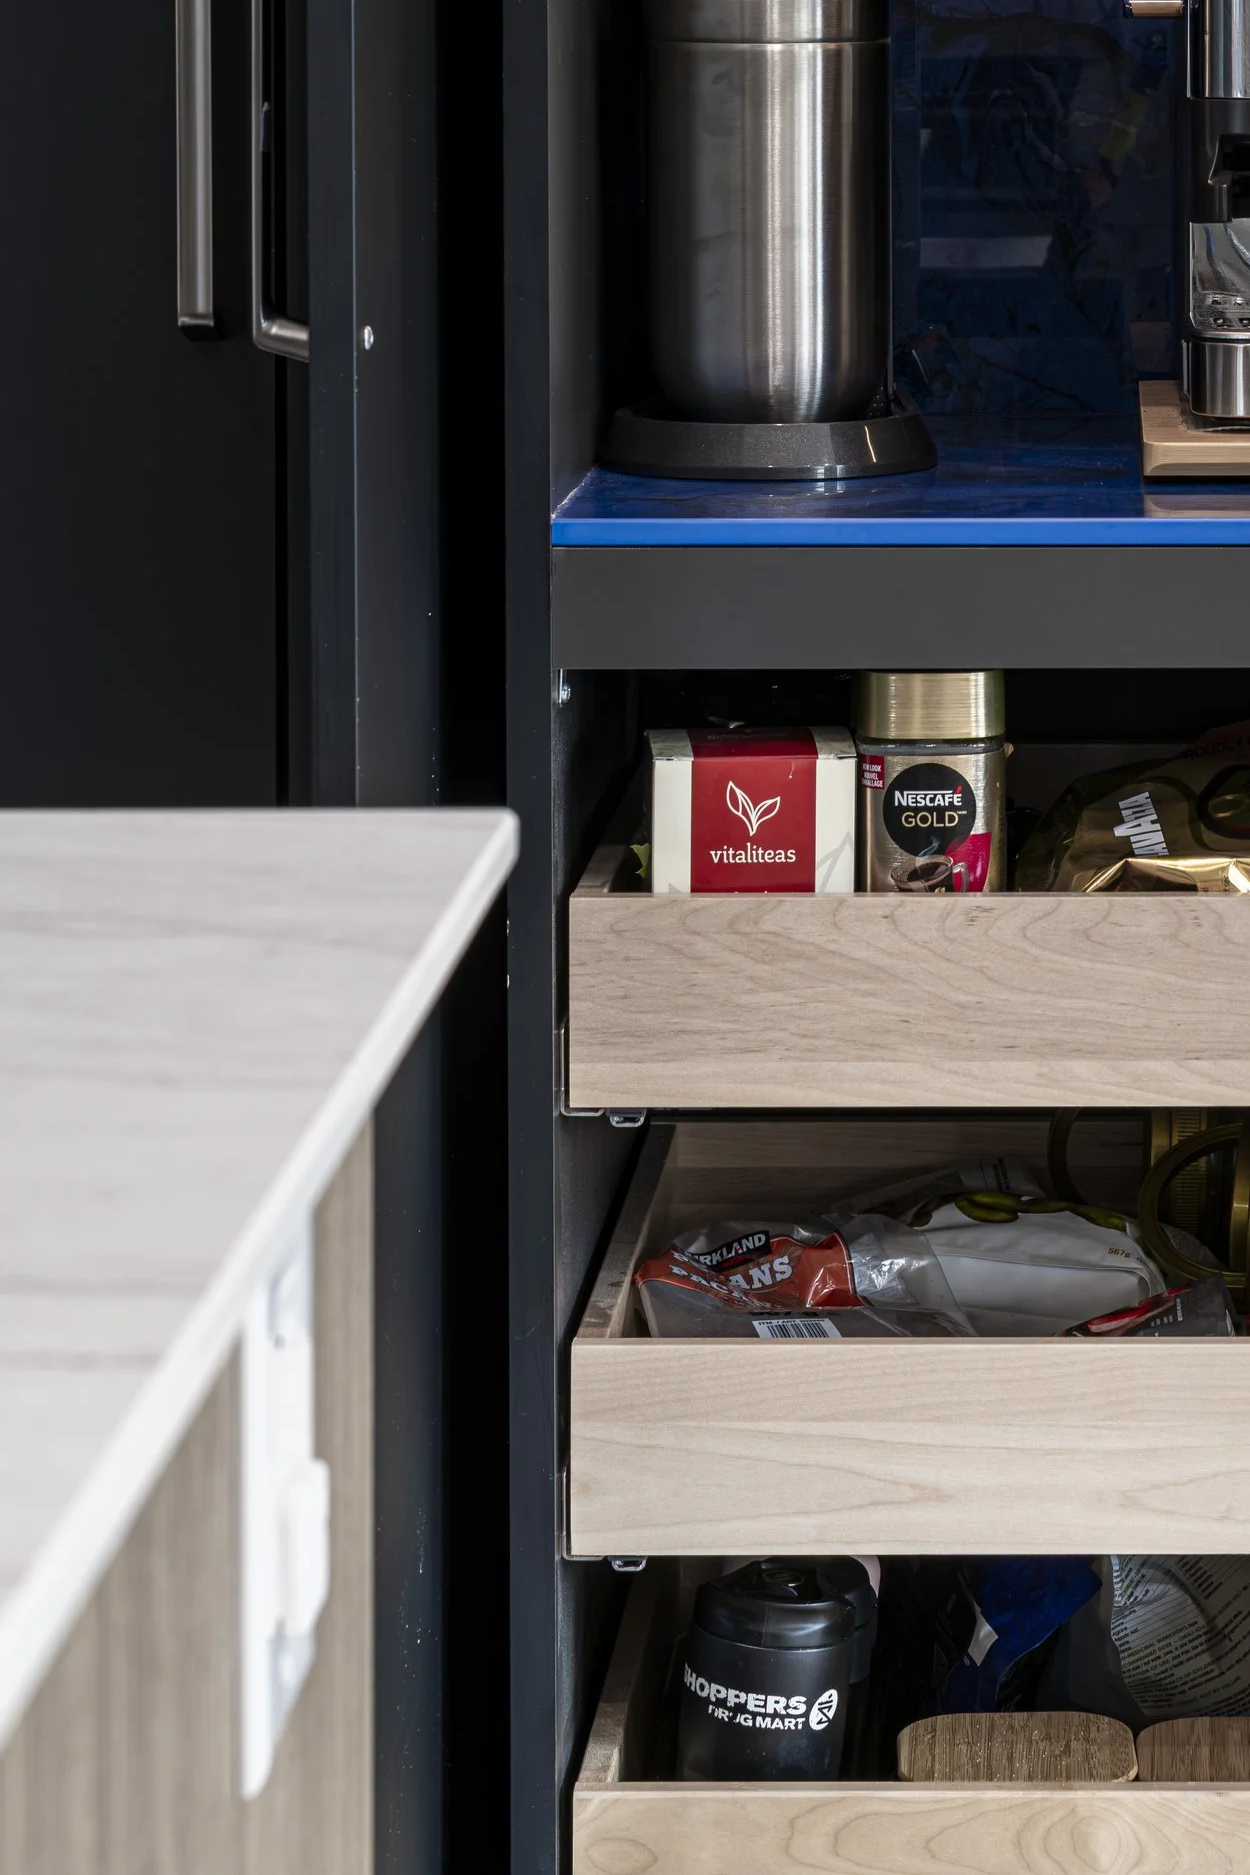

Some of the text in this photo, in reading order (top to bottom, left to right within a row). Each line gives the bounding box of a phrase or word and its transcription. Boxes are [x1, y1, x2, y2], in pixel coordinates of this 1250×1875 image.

[894, 785, 963, 807] NESCAFÉ
[901, 811, 959, 828] GOLD
[710, 842, 797, 864] vitaliteas
[690, 1232, 767, 1268] IRKLAND
[755, 1716, 806, 1731] MART
